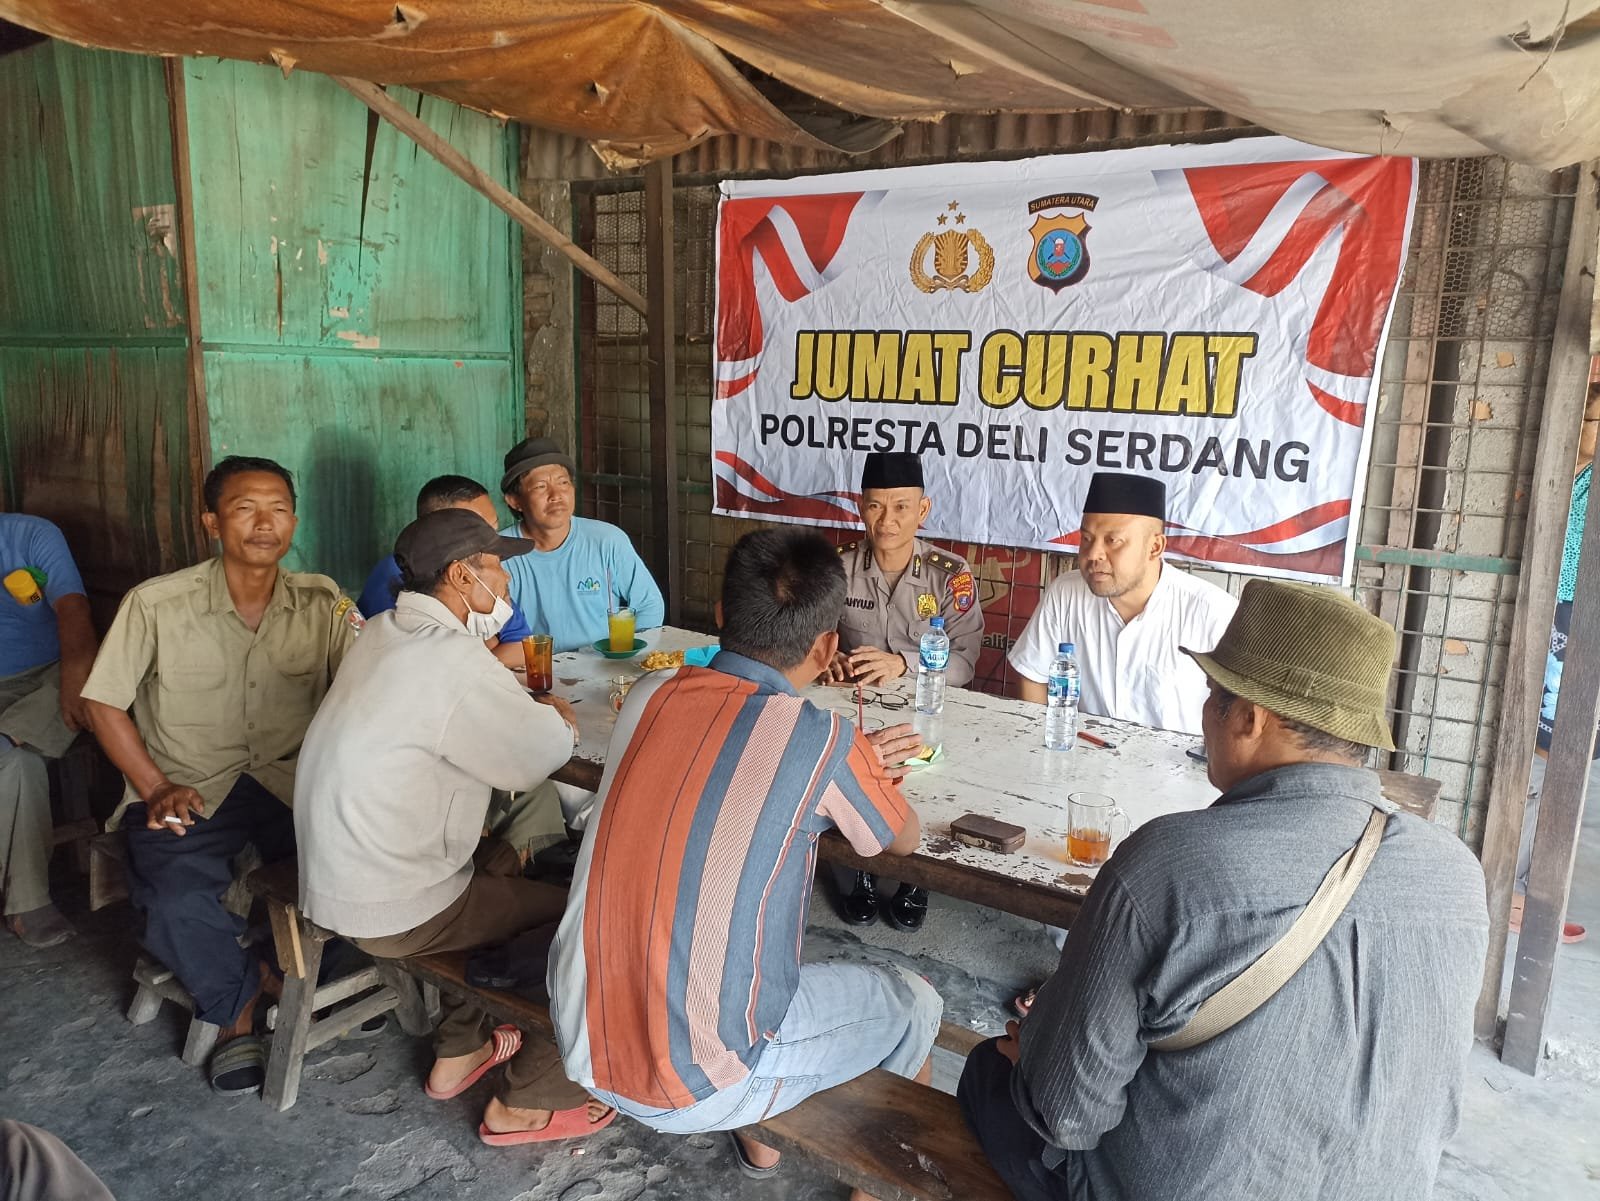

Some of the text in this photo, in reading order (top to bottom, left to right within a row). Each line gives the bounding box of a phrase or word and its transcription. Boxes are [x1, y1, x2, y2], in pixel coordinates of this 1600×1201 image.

[1030, 196, 1094, 211] SUMATERA UTARA
[790, 329, 1259, 418] JUMAT CURHAT
[760, 413, 1310, 483] POLRESTA DELI SERDANG
